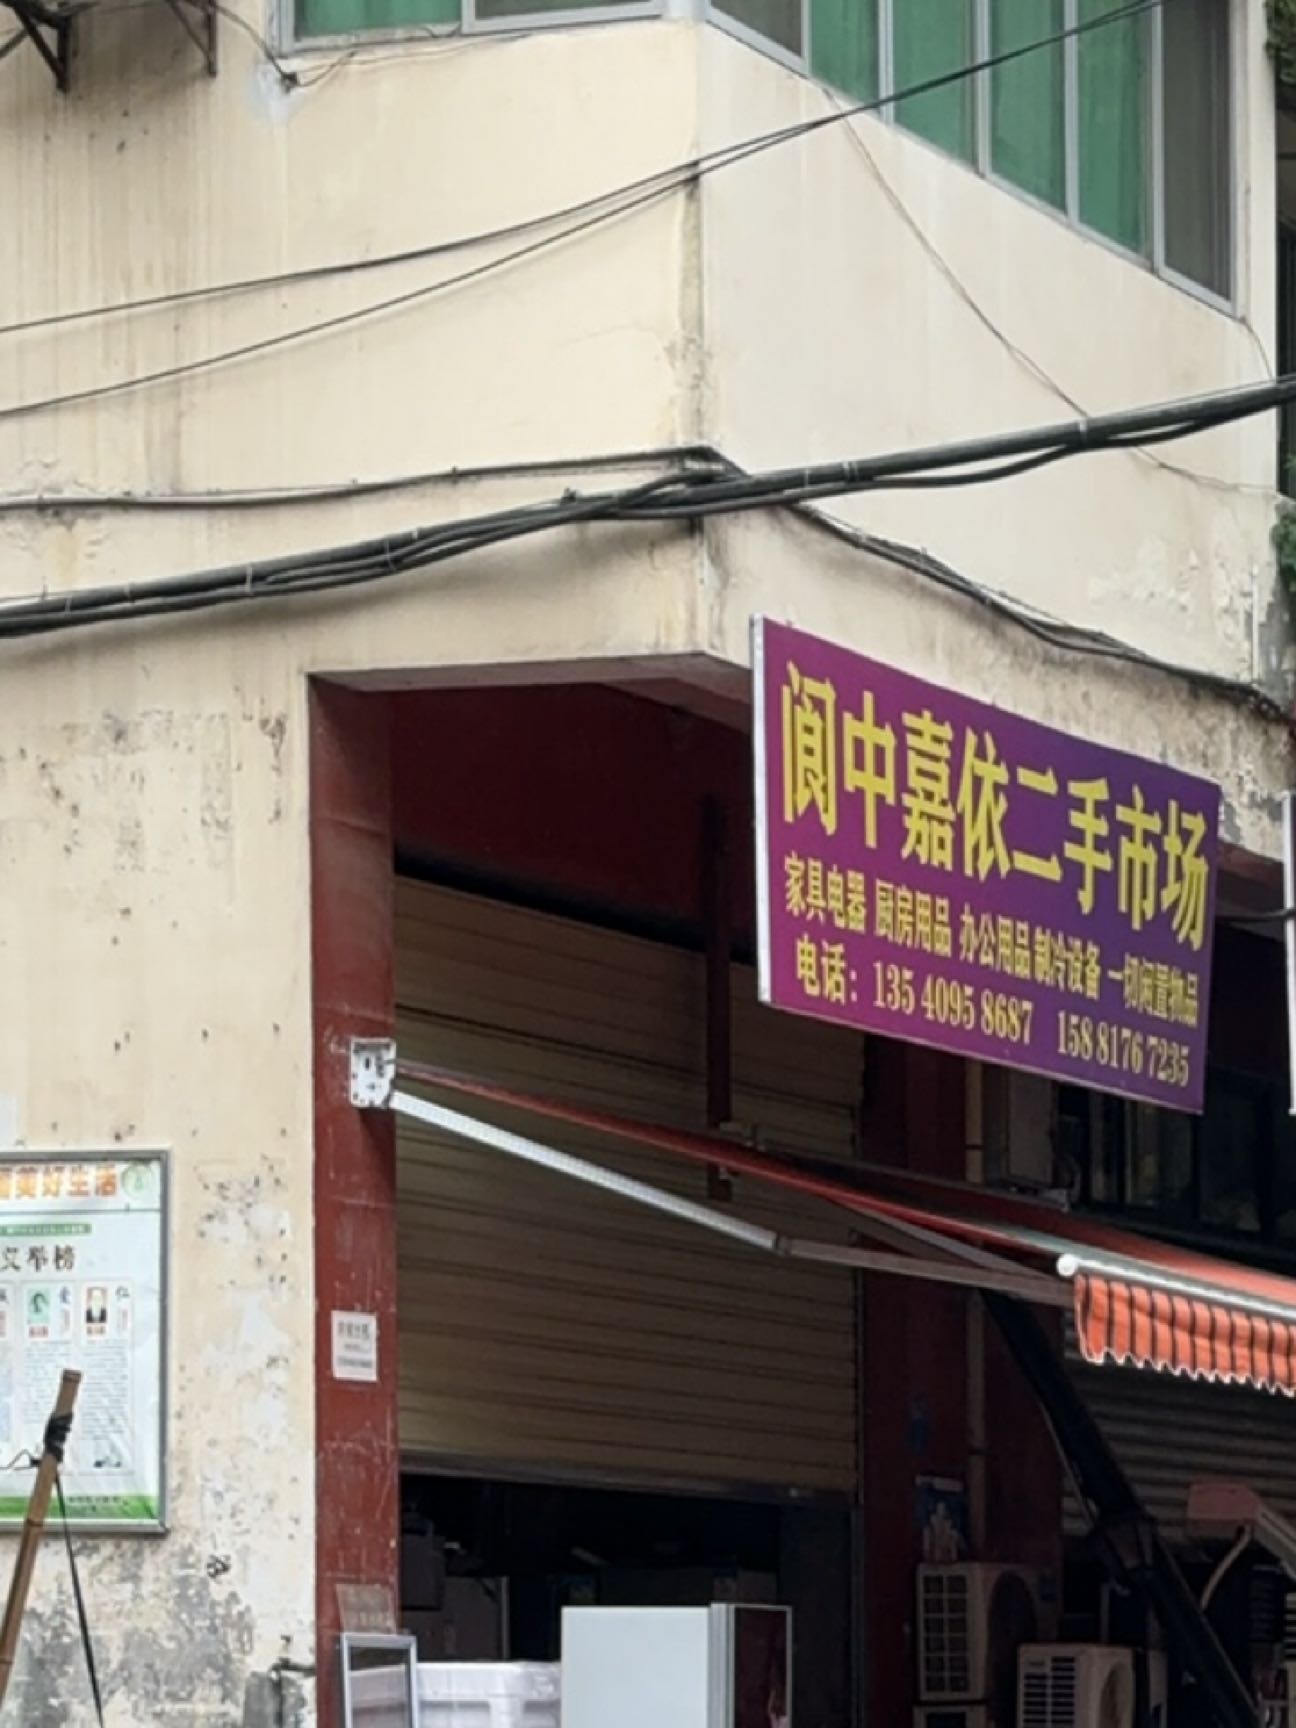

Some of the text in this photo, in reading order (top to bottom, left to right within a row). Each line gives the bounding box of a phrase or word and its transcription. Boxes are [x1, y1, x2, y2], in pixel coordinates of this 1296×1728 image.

[782, 660, 1210, 951] 阆中嘉依二手市场
[784, 850, 866, 935] 家具电器
[874, 877, 952, 958] 厨房用品
[873, 960, 916, 1015] 135
[921, 973, 975, 1031] 4095
[980, 988, 1034, 1045] 8687
[1057, 1010, 1093, 1061] 158
[1096, 1022, 1144, 1074] 8176
[1146, 1035, 1190, 1088] 7235
